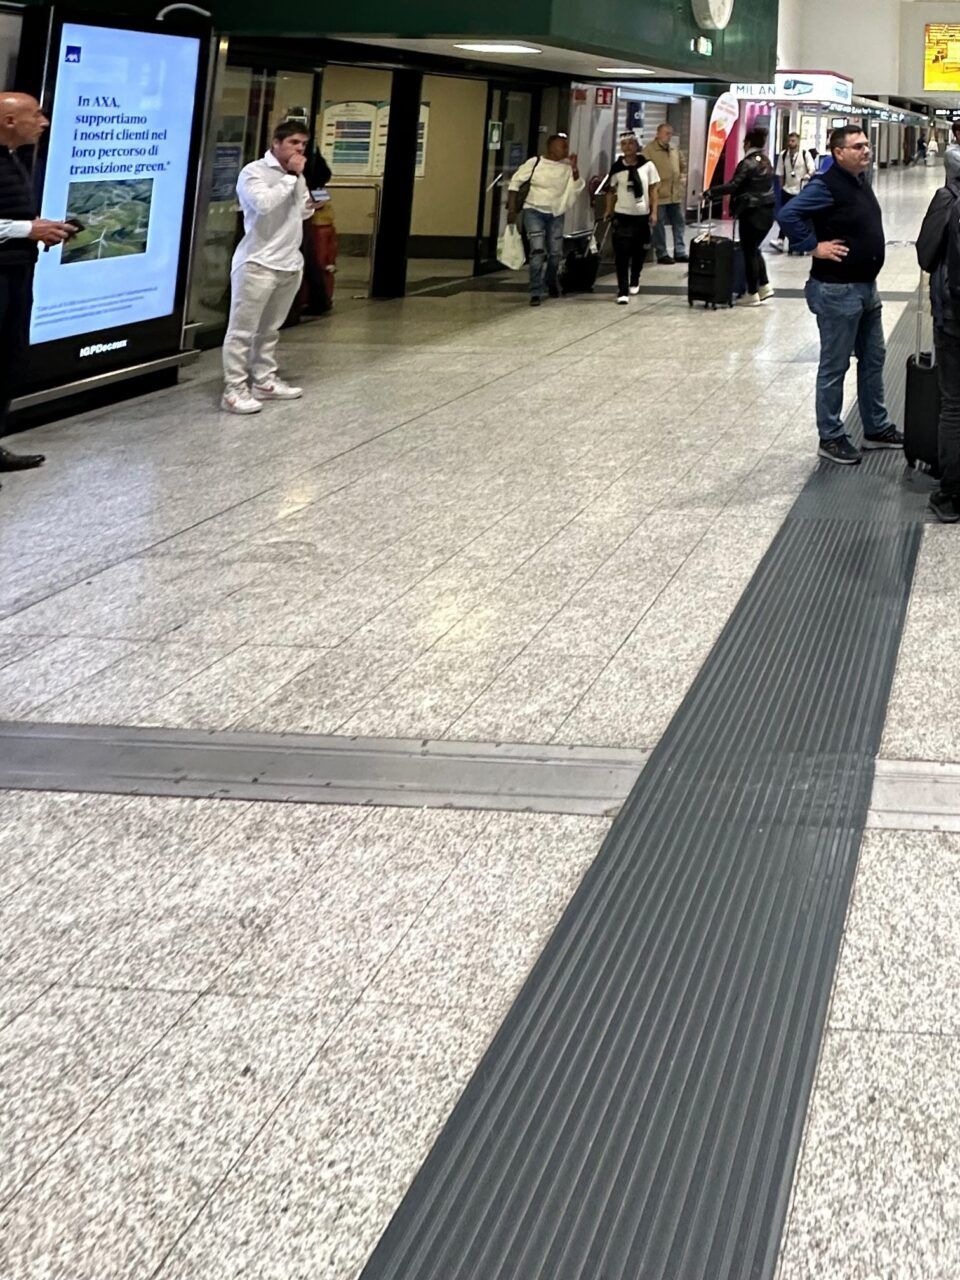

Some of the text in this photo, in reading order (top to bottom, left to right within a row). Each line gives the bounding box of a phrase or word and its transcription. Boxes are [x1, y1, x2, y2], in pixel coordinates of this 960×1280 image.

[78, 95, 121, 109] In AXA,
[75, 112, 147, 127] supportiamo
[80, 128, 115, 141] nostri
[116, 128, 150, 141] clienti
[151, 129, 168, 141] nel
[71, 144, 160, 160] loro percorso di
[69, 161, 134, 176] transizione
